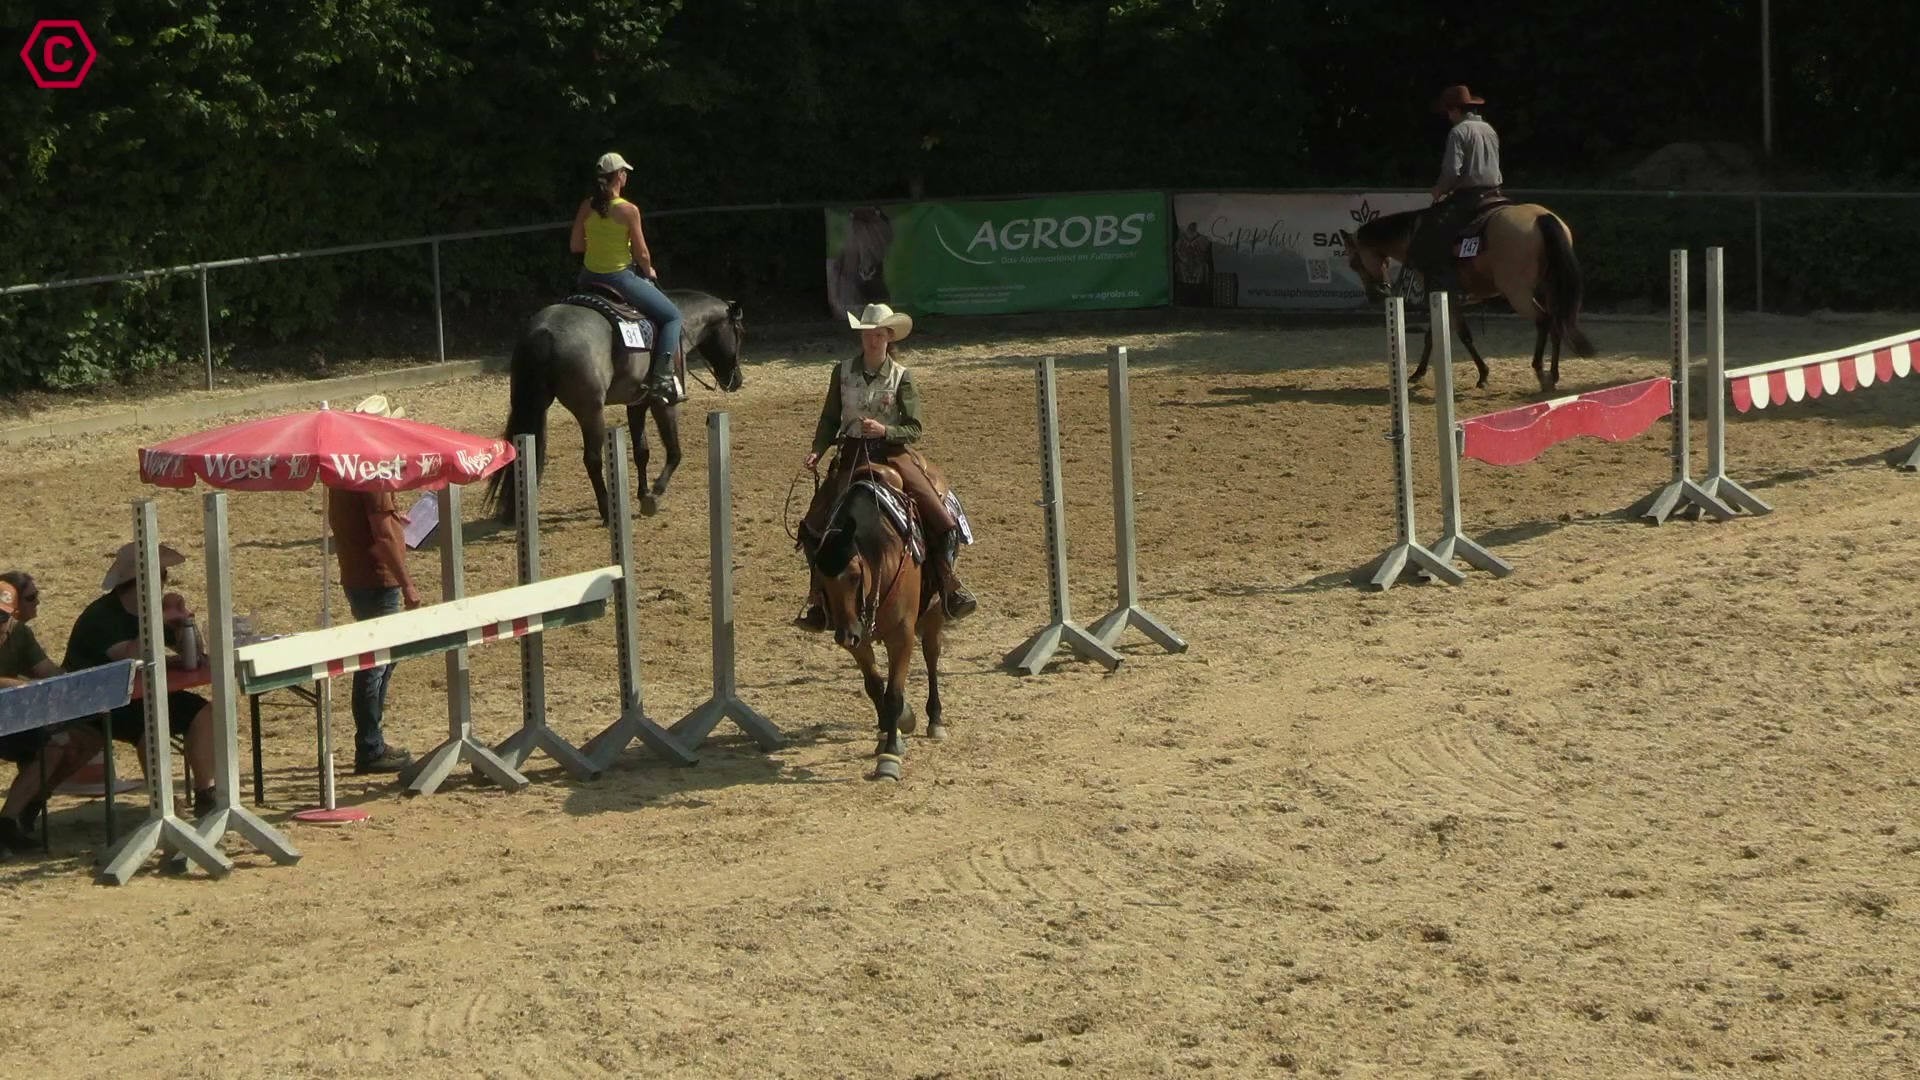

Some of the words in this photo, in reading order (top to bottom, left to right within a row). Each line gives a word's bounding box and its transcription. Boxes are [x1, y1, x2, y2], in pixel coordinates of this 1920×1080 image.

[1463, 240, 1478, 254] 147
[1001, 256, 1017, 265] Das
[625, 329, 639, 345] 91
[204, 453, 276, 481] West
[330, 453, 406, 481] West
